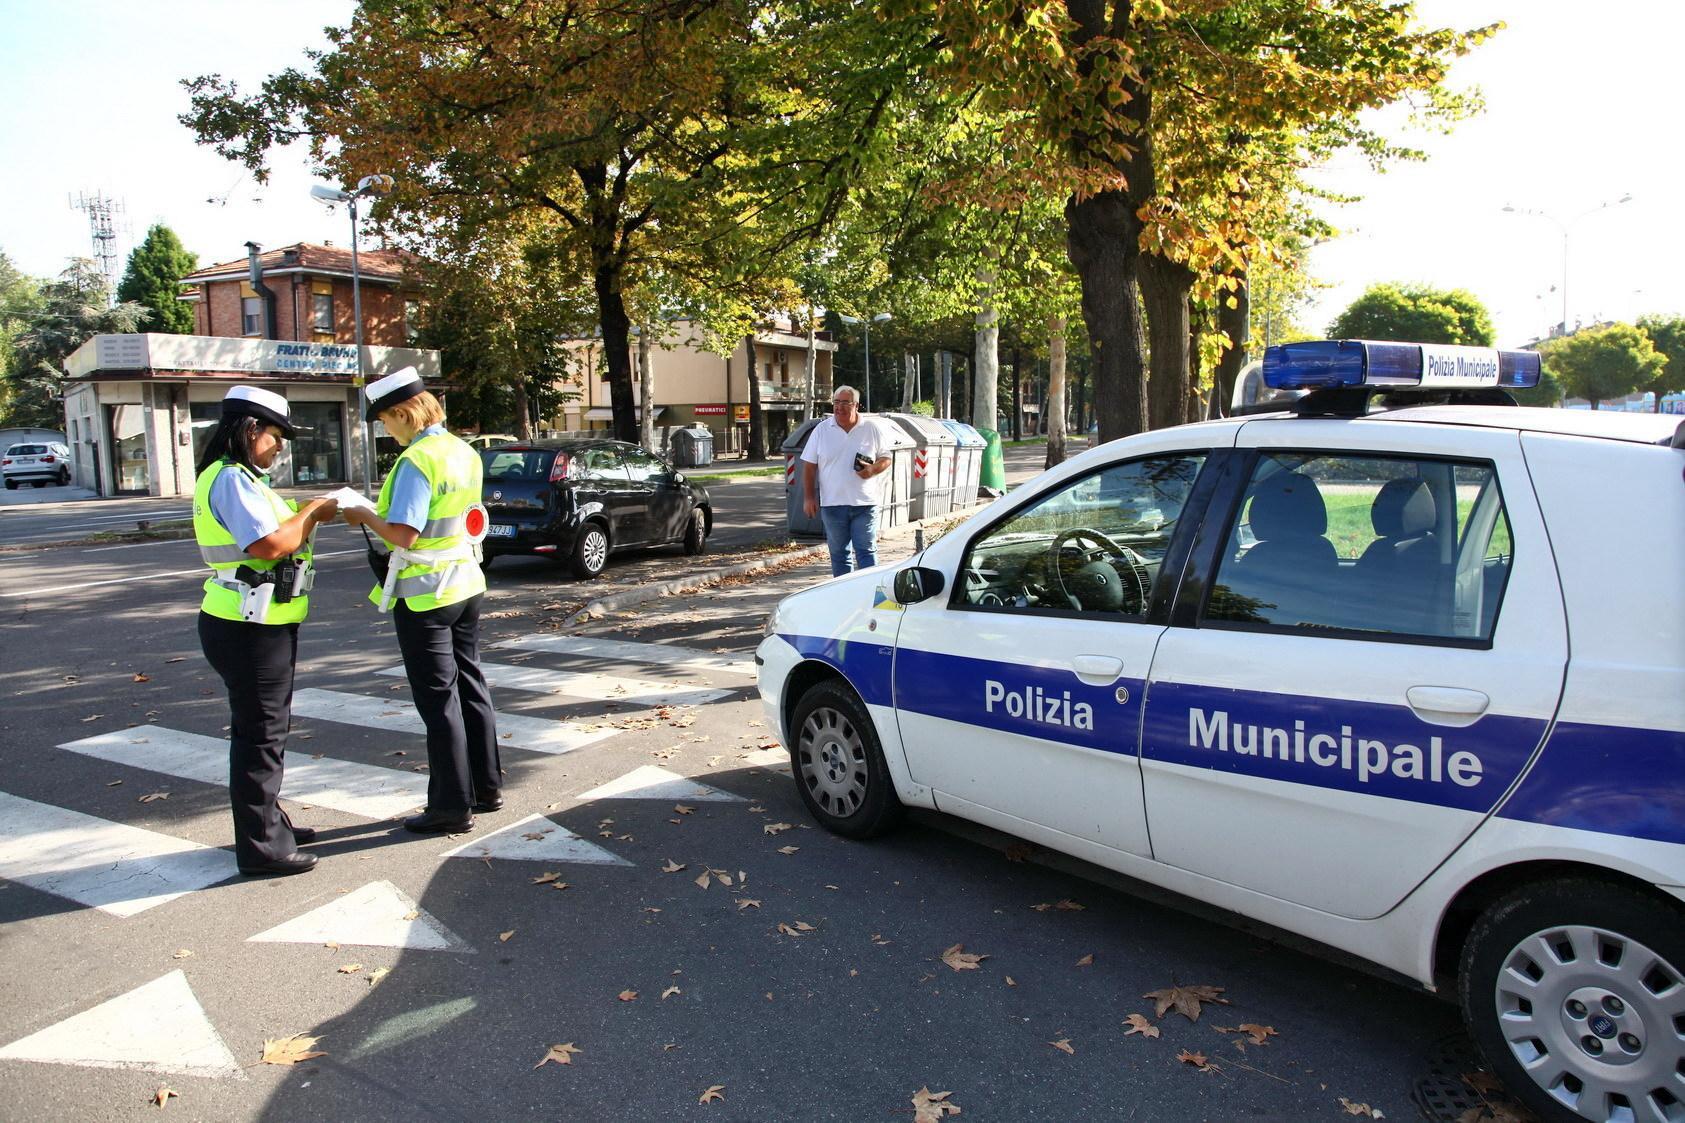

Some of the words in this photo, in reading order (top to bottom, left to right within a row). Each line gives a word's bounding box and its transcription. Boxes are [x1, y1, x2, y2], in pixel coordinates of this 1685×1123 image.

[277, 344, 310, 356] FRATI
[1428, 355, 1455, 377] Polizia
[1456, 356, 1497, 381] Municipale
[985, 679, 1094, 731] Polizia
[1189, 707, 1483, 788] Municipale
